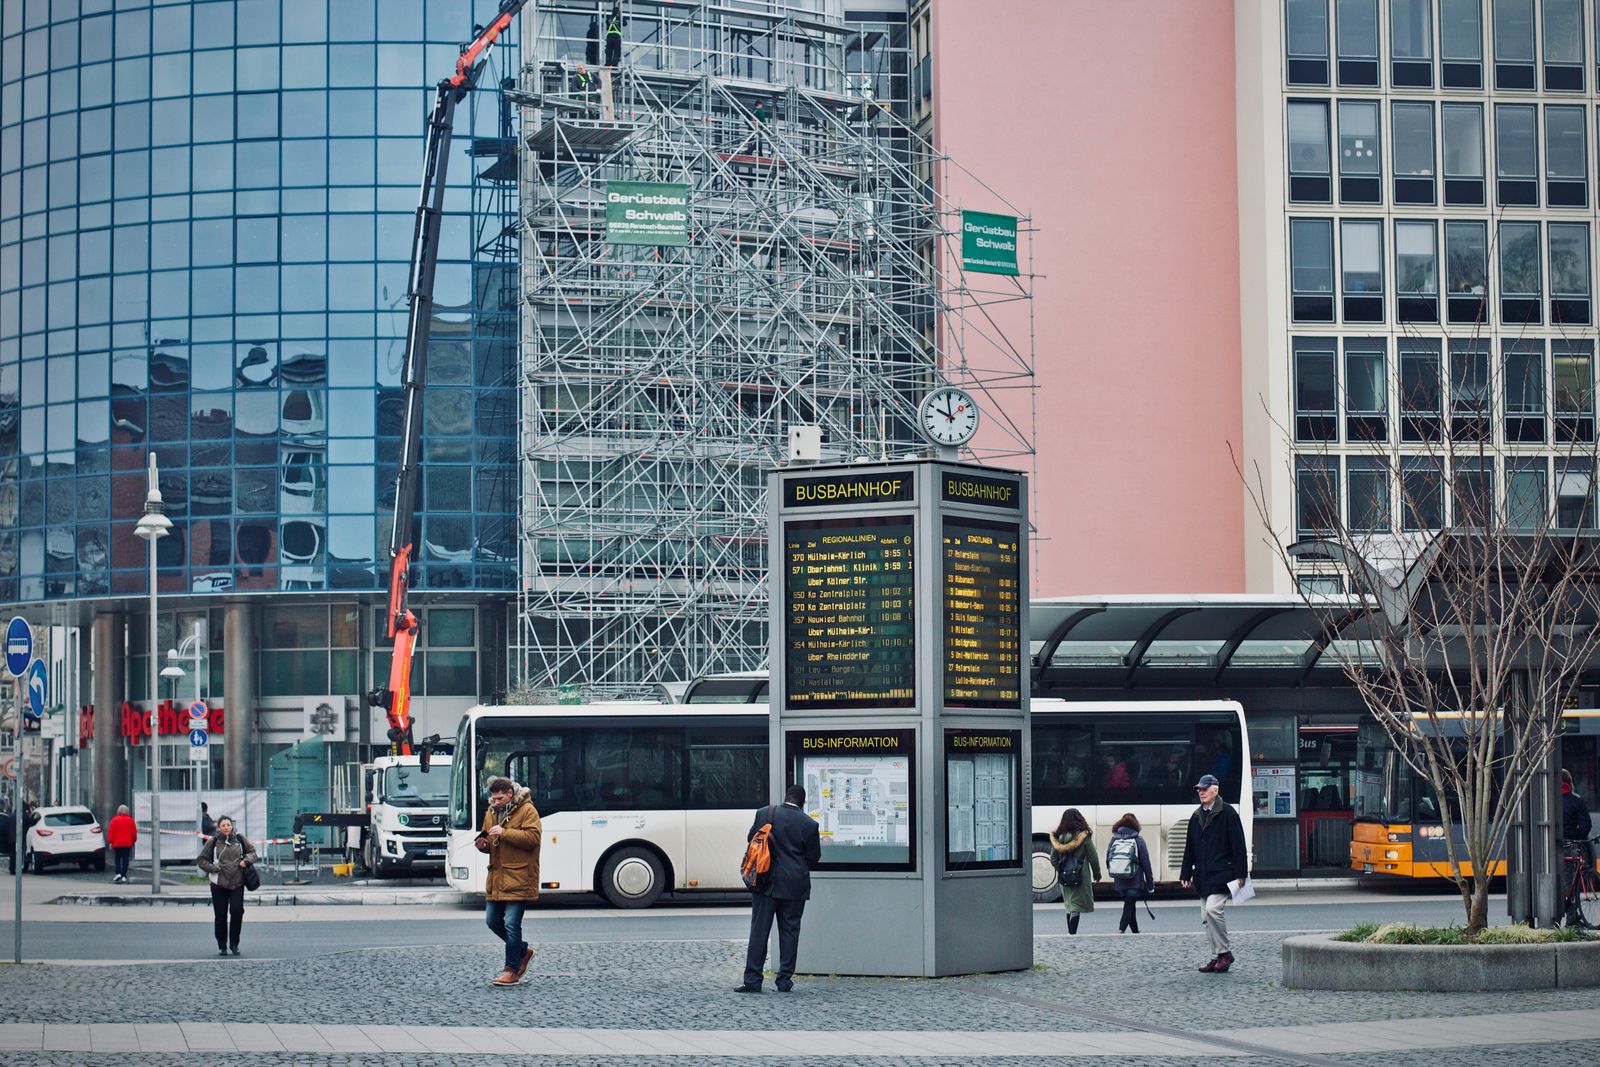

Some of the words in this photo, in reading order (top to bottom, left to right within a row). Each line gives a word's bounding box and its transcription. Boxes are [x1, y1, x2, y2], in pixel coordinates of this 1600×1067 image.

[608, 192, 686, 206] Gerüstbau
[625, 209, 687, 222] Schwalb
[964, 222, 1016, 238] Gerüstbau
[976, 238, 1015, 252] Schwalb
[796, 480, 902, 501] BUSBAHNHOF
[948, 480, 1012, 502] BUSBAHNHOF
[822, 534, 877, 544] REGIONALLINIEN
[792, 554, 804, 562] 370
[808, 551, 866, 561] Mülheim-Kärlich
[884, 549, 901, 558] 9:55
[792, 566, 804, 574] 571
[808, 564, 848, 574] Oberlahnst.
[854, 563, 878, 572] Klinik
[884, 562, 901, 570] 9:59
[827, 576, 850, 586] Kölner
[854, 576, 868, 584] Str.
[808, 590, 816, 598] Ko
[820, 588, 866, 598] Zentralplatz
[882, 587, 902, 596] 10:02
[792, 603, 804, 611] 570
[808, 603, 816, 611] Ko
[820, 600, 866, 611] Zentralplatz
[882, 600, 902, 608] 10:03
[793, 616, 804, 624] 357
[808, 616, 836, 624] Neuwied
[838, 614, 866, 623] Bahnhof
[827, 626, 876, 636] Mülheim-Kärl.
[808, 638, 867, 649] Mülheim-Kärlich
[827, 652, 870, 661] Rheindörfer
[808, 666, 820, 674] Lay
[803, 736, 898, 748] BUS-INFORMATION
[953, 736, 1012, 748] BUS-INFORMATION
